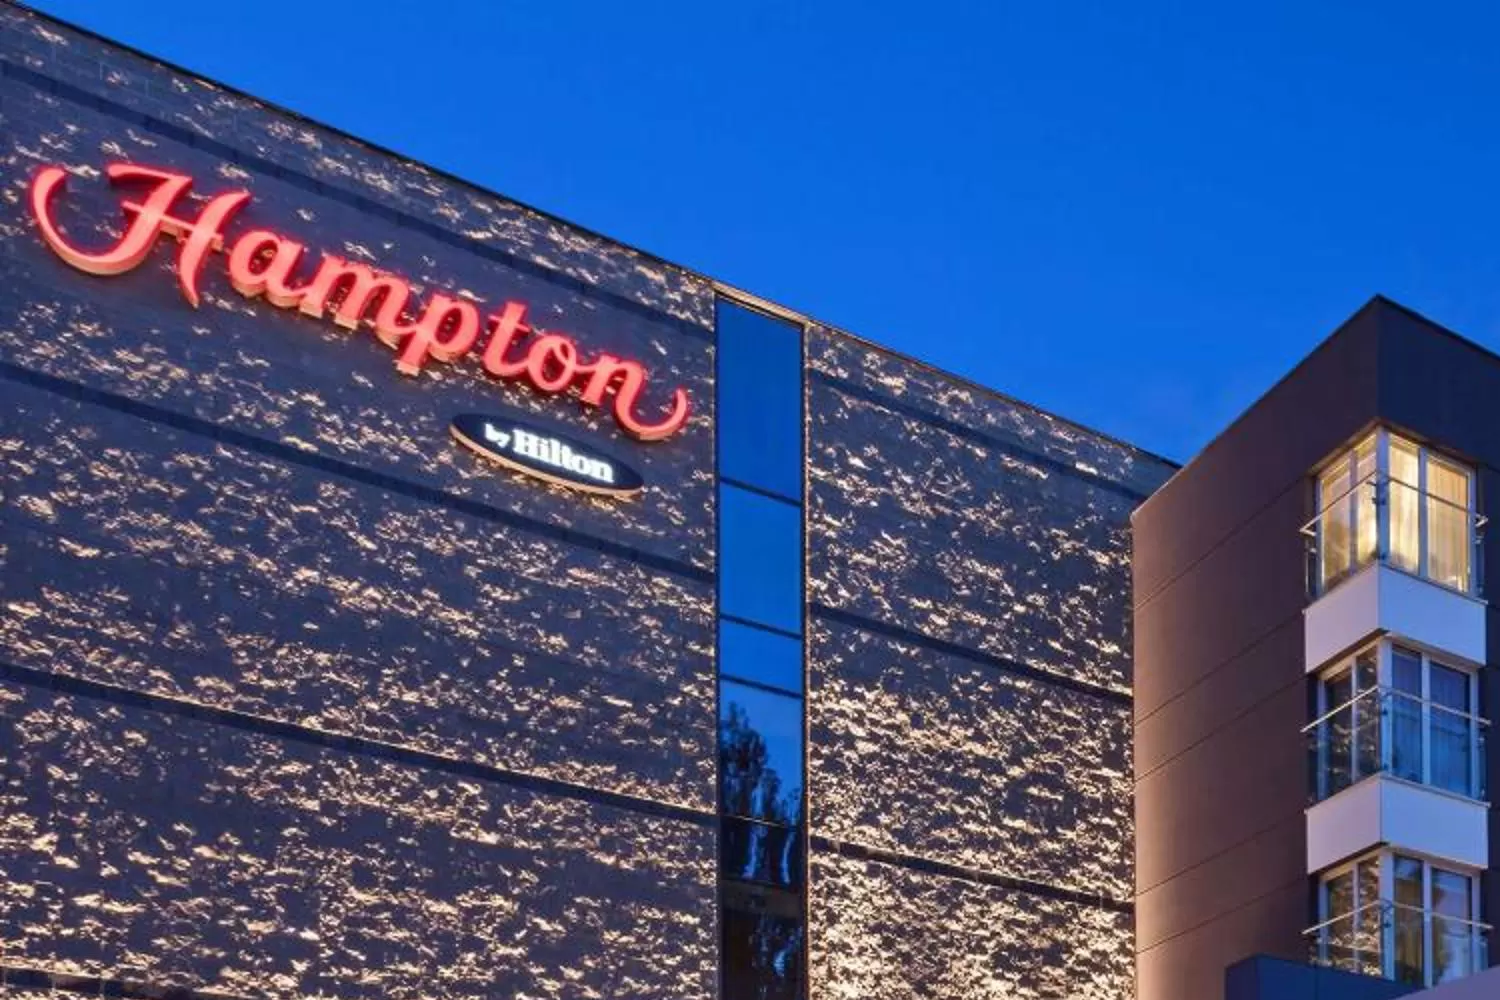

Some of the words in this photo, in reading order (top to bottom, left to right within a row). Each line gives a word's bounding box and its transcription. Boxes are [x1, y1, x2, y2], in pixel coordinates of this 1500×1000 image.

[30, 162, 688, 442] Hampton
[484, 423, 511, 448] by
[513, 429, 615, 483] Hilton
